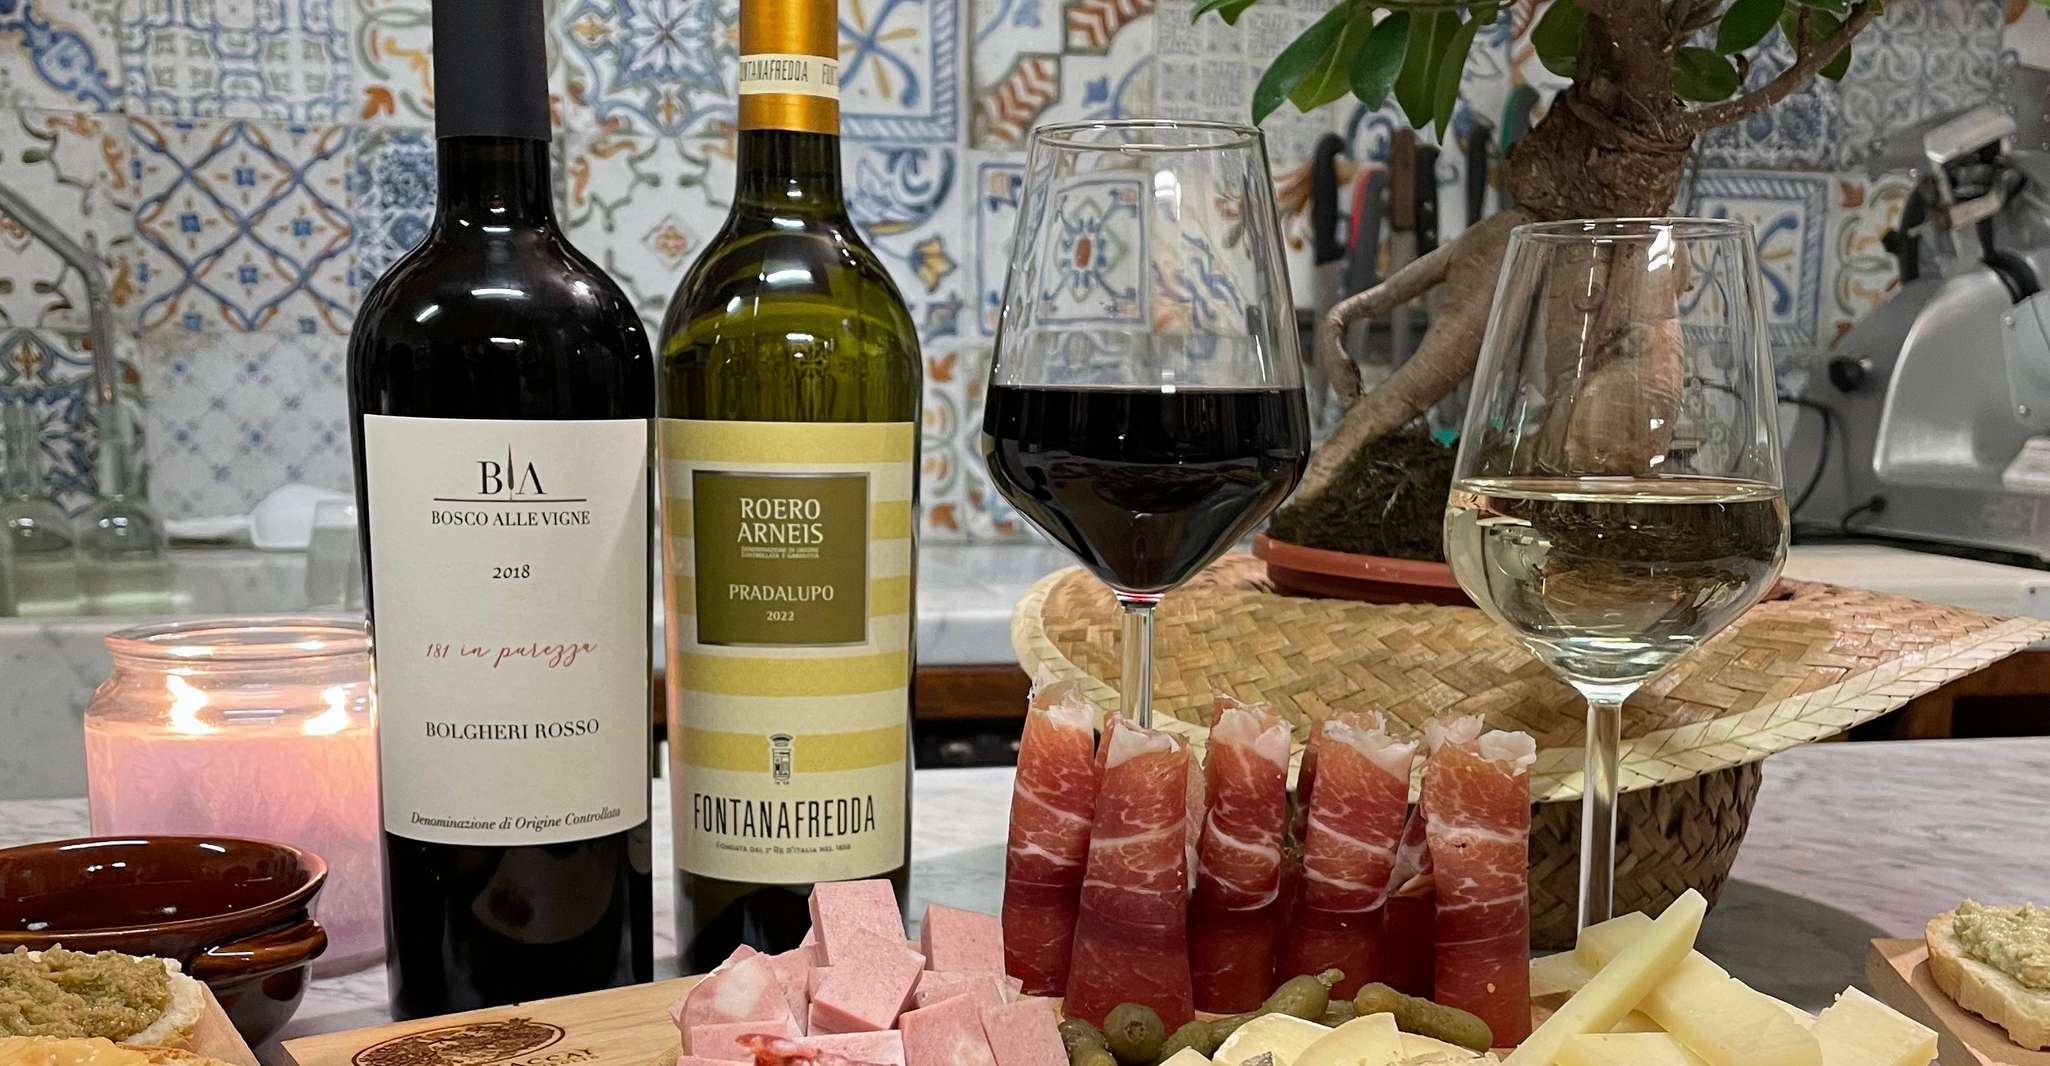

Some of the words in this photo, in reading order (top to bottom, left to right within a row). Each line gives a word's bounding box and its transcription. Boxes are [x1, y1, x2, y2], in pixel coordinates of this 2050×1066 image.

[431, 510, 489, 525] BOSCO
[492, 512, 538, 526] ALLE
[541, 510, 591, 526] VIGNE
[740, 497, 821, 520] ROERO
[737, 522, 824, 544] ARNEIS
[492, 564, 530, 579] 2018
[728, 583, 834, 602] PRADALUPO
[766, 610, 795, 622] 2022
[426, 643, 450, 659] 181
[460, 644, 492, 658] in
[493, 642, 598, 669] purezza
[425, 721, 528, 740] BOLGHERI
[535, 718, 600, 739] ROSSO
[411, 811, 496, 830] Denominazione
[499, 816, 512, 830] di
[515, 813, 562, 832] Origine
[565, 807, 621, 826] Controllata
[693, 793, 876, 839] FONTANAFREDDA
